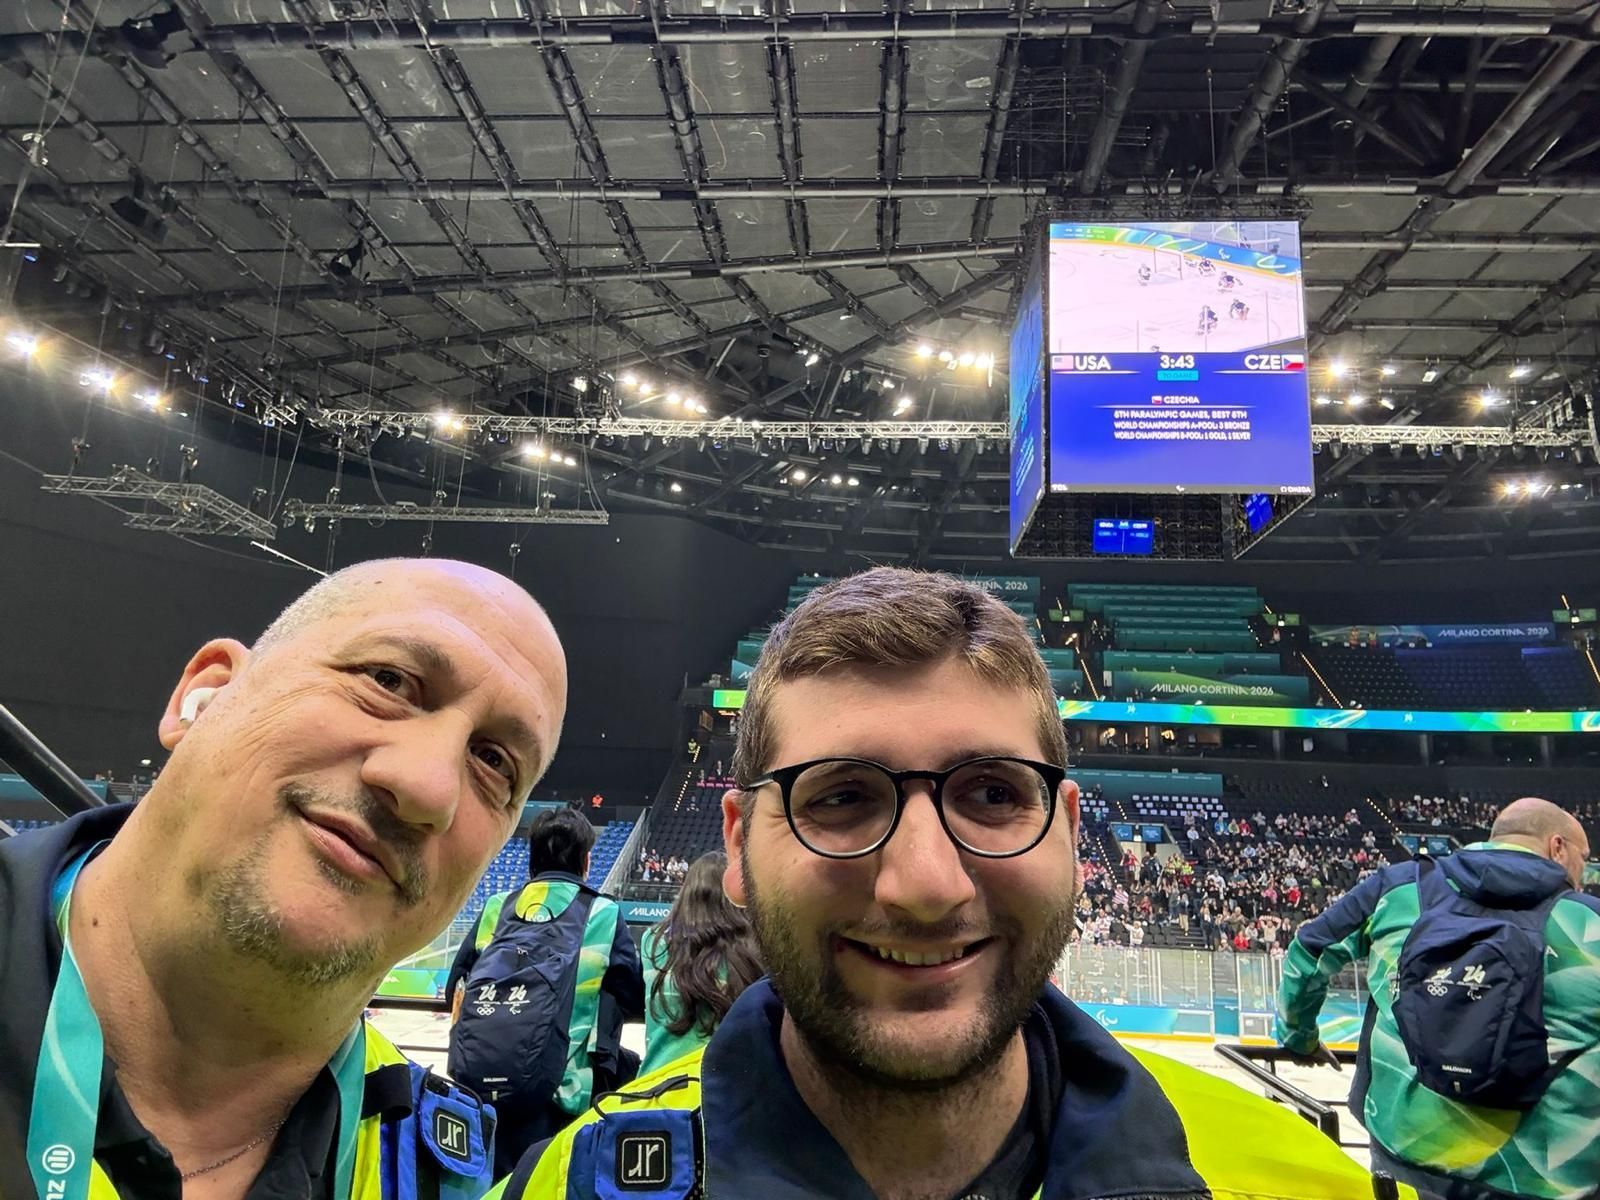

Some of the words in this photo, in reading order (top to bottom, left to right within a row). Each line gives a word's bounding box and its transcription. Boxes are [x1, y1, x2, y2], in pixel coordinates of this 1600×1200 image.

[1075, 356, 1111, 370] USA
[1160, 355, 1195, 369] 3:43
[1244, 355, 1281, 369] CZE
[1164, 396, 1200, 404] CZECHIA
[1131, 410, 1178, 419] PARALYMPIC
[1180, 410, 1210, 420] GAMES,
[1212, 410, 1230, 419] BEST
[1114, 421, 1137, 429] WORLD
[1138, 421, 1190, 429] CHAMPIONSHIPS
[1224, 421, 1250, 429] BRONZE
[1114, 431, 1135, 440] WORLD
[1135, 431, 1180, 440] CHAMPIONSHIPS
[1005, 580, 1028, 590] 2026
[1438, 629, 1479, 638] MILANO
[1481, 628, 1525, 637] CORTINA
[1527, 627, 1550, 636] 2026
[1150, 684, 1198, 694] MILANO
[1199, 684, 1248, 695] CORTINA
[1250, 686, 1274, 696] 2026
[628, 907, 671, 917] MILANO
